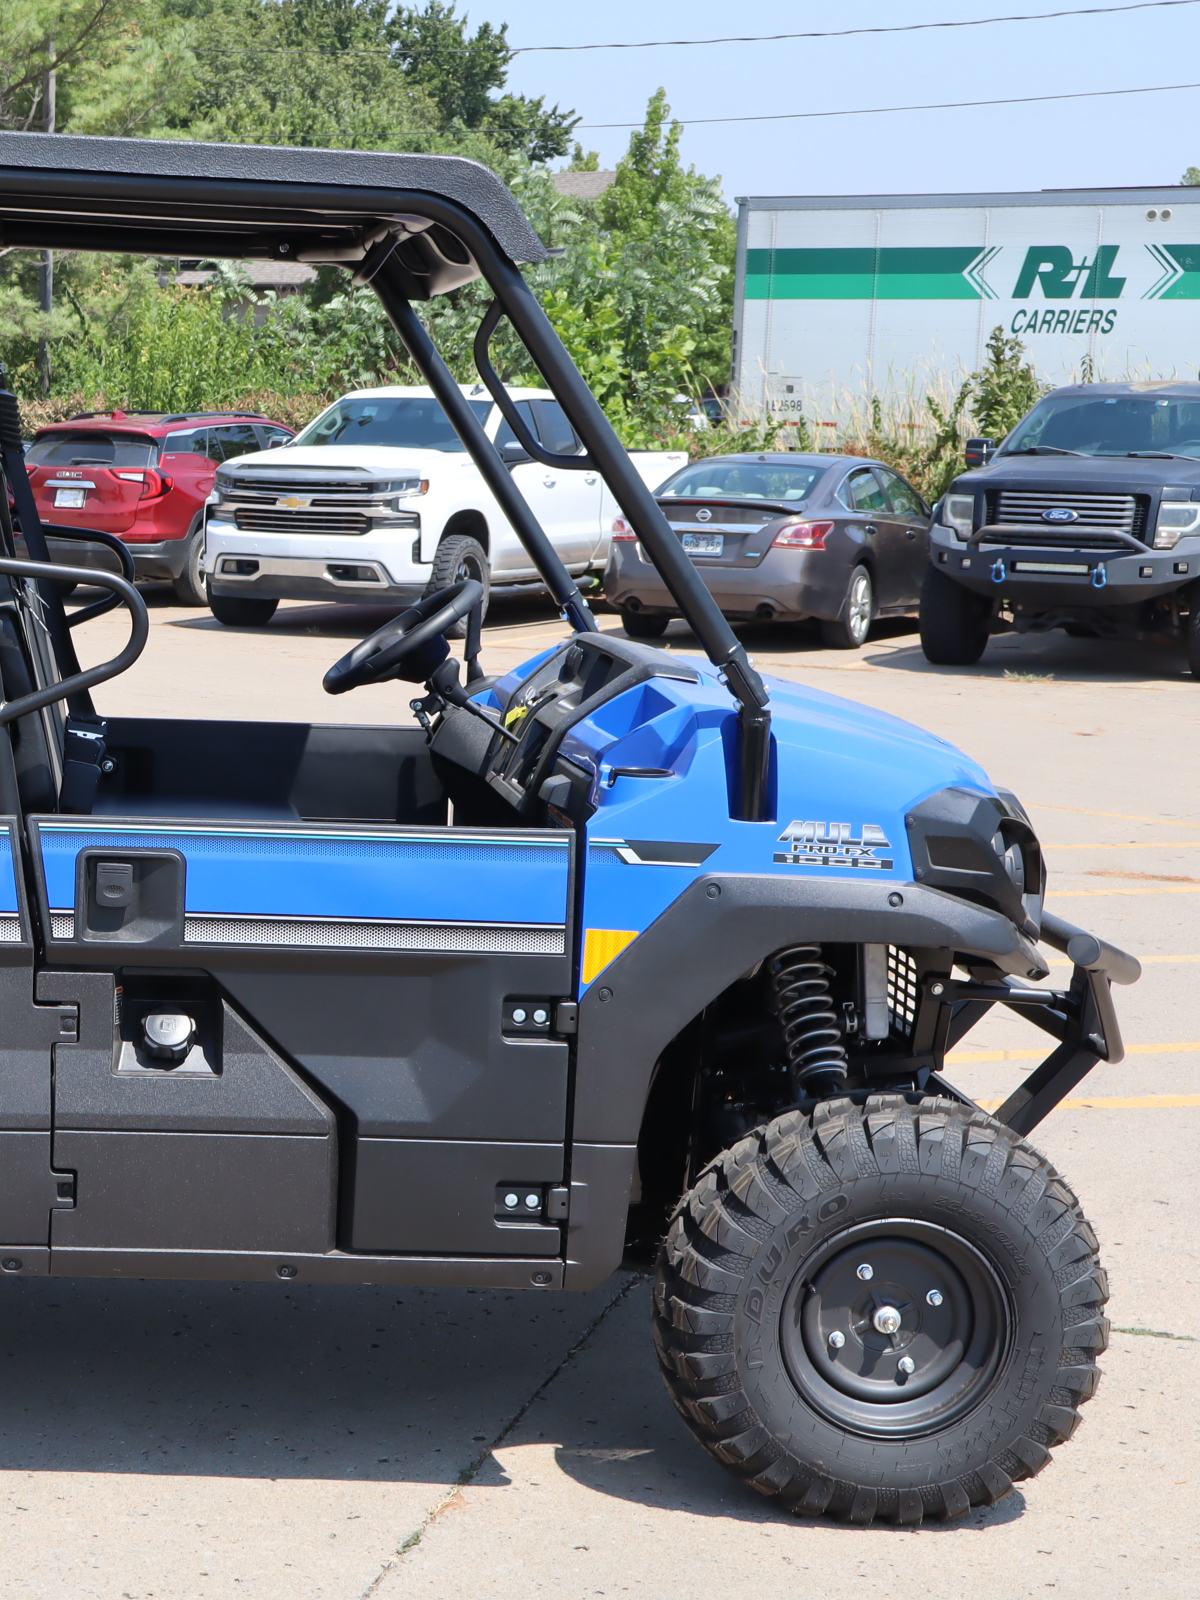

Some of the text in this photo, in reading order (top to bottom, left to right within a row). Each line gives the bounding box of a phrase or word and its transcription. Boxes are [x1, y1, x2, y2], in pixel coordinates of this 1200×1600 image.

[1011, 309, 1118, 334] CARRIERS
[1049, 510, 1069, 519] Ford
[777, 820, 892, 848] MULE
[792, 843, 876, 857] PRO-FX
[784, 854, 882, 868] 1000
[744, 1192, 849, 1325] DURO
